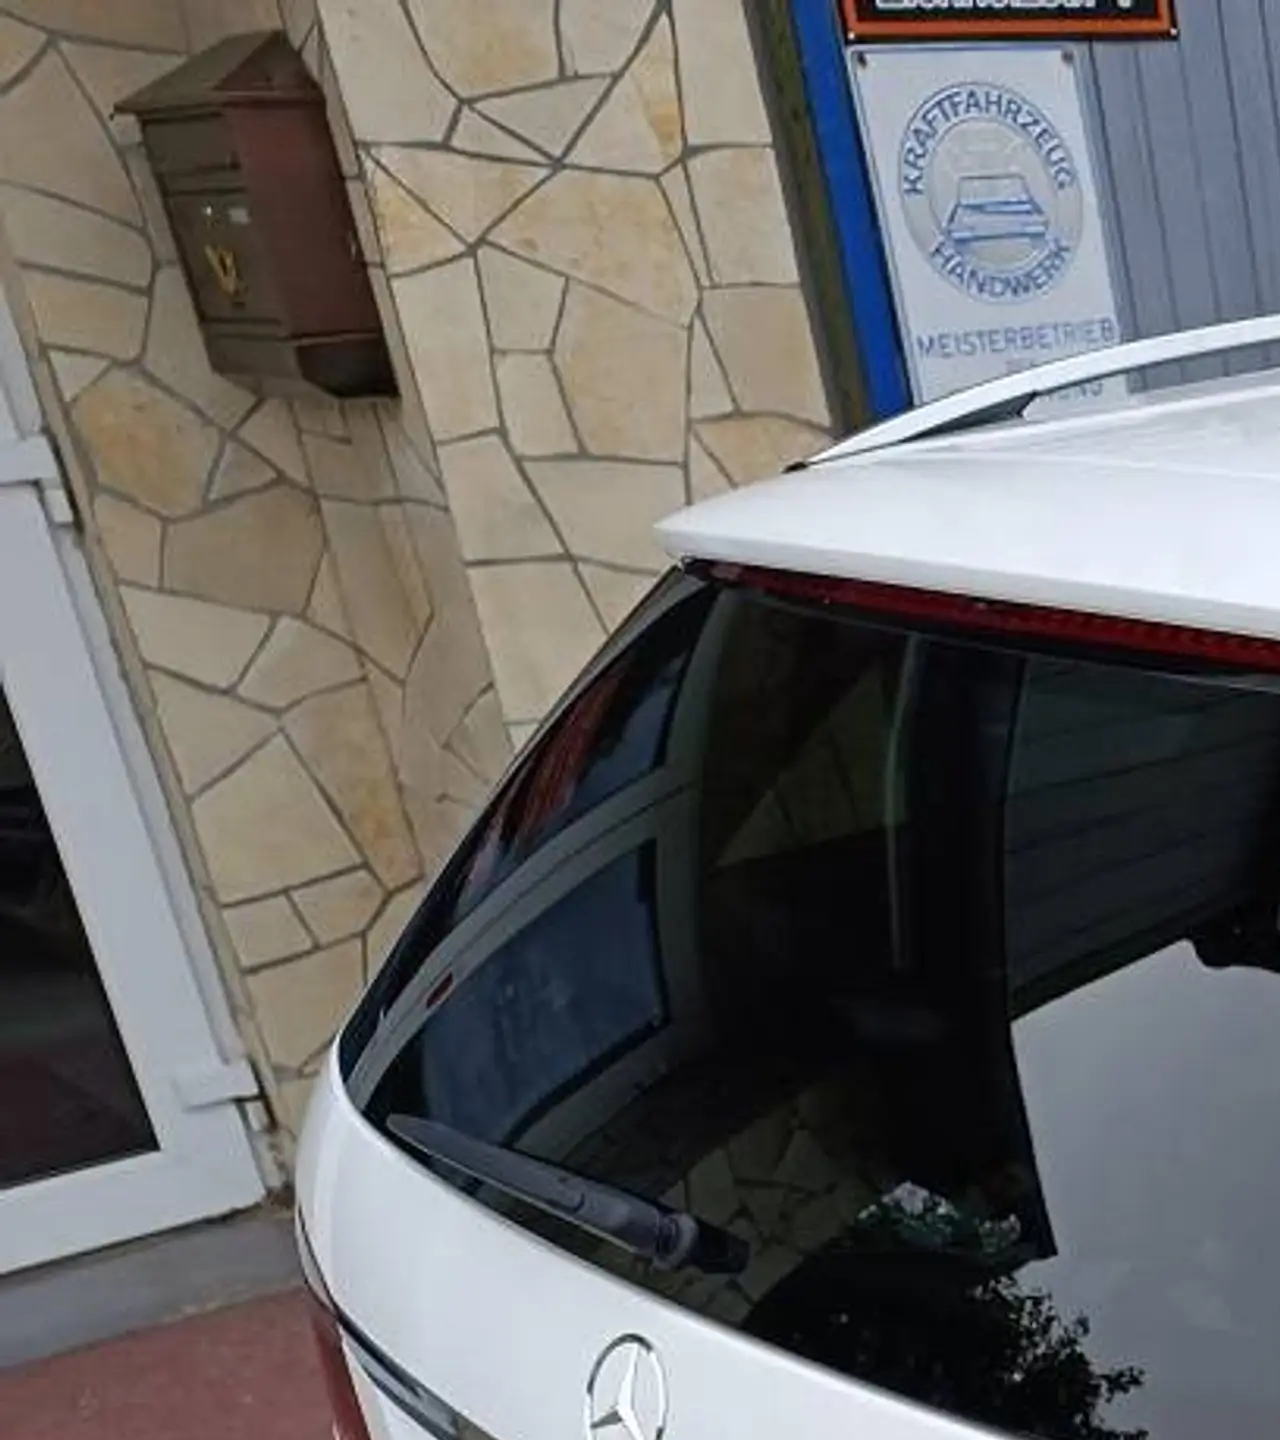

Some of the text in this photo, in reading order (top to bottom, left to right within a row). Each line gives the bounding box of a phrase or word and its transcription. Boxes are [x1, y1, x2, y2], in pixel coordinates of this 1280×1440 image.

[903, 89, 1075, 197] KRAFTFAHRZEUG
[930, 234, 1072, 299] HANDWERK
[916, 317, 1117, 359] MEISTERBETRIEB
